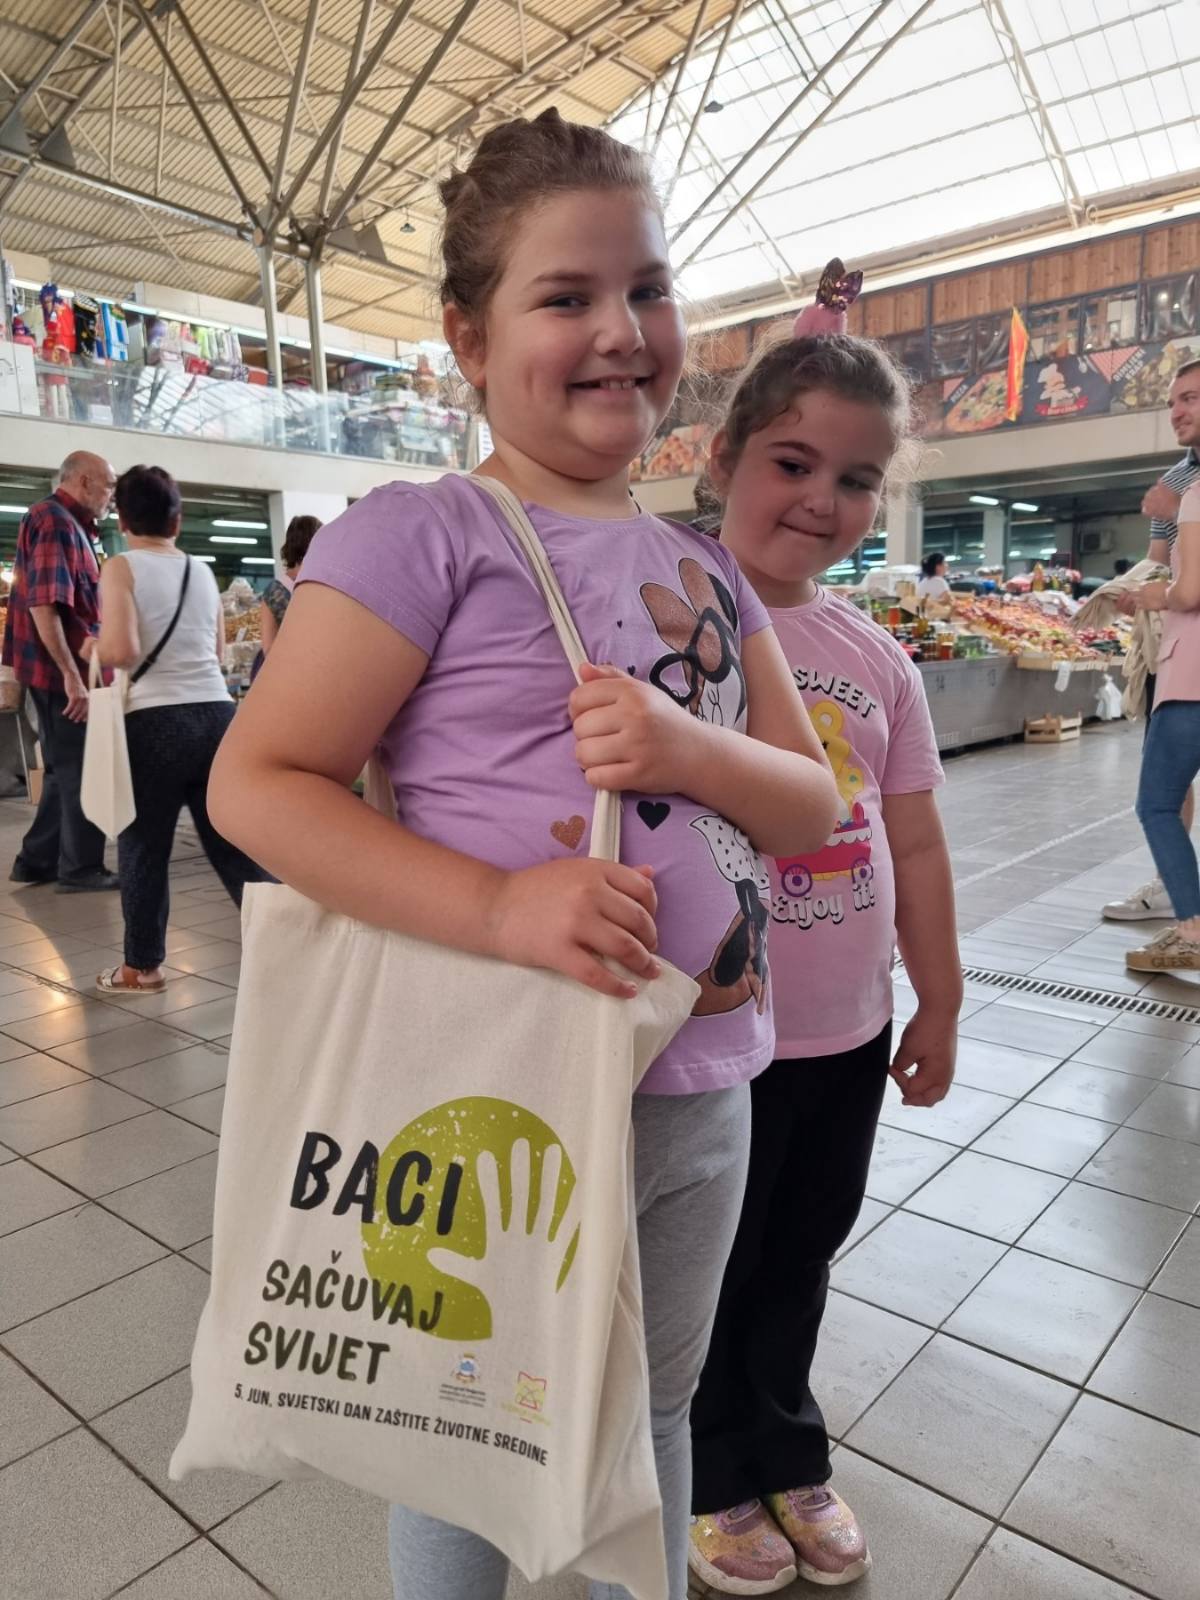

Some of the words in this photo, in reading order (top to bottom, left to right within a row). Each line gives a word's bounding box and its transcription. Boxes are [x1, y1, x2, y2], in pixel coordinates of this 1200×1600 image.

[792, 665, 876, 718] SWEET
[772, 893, 845, 930] Enjoy
[1151, 956, 1195, 969] GUESS
[290, 1131, 462, 1235] BACI
[262, 1249, 443, 1331] SAČUVAJ
[244, 1321, 390, 1384] SVIJET
[234, 1382, 243, 1400] 5.
[277, 1392, 340, 1415] SVJETSKI
[343, 1402, 372, 1421] DAN
[374, 1407, 431, 1432] ZAŠTITE
[433, 1416, 490, 1445] ŽIVOTNE
[493, 1431, 548, 1466] SREDINE
